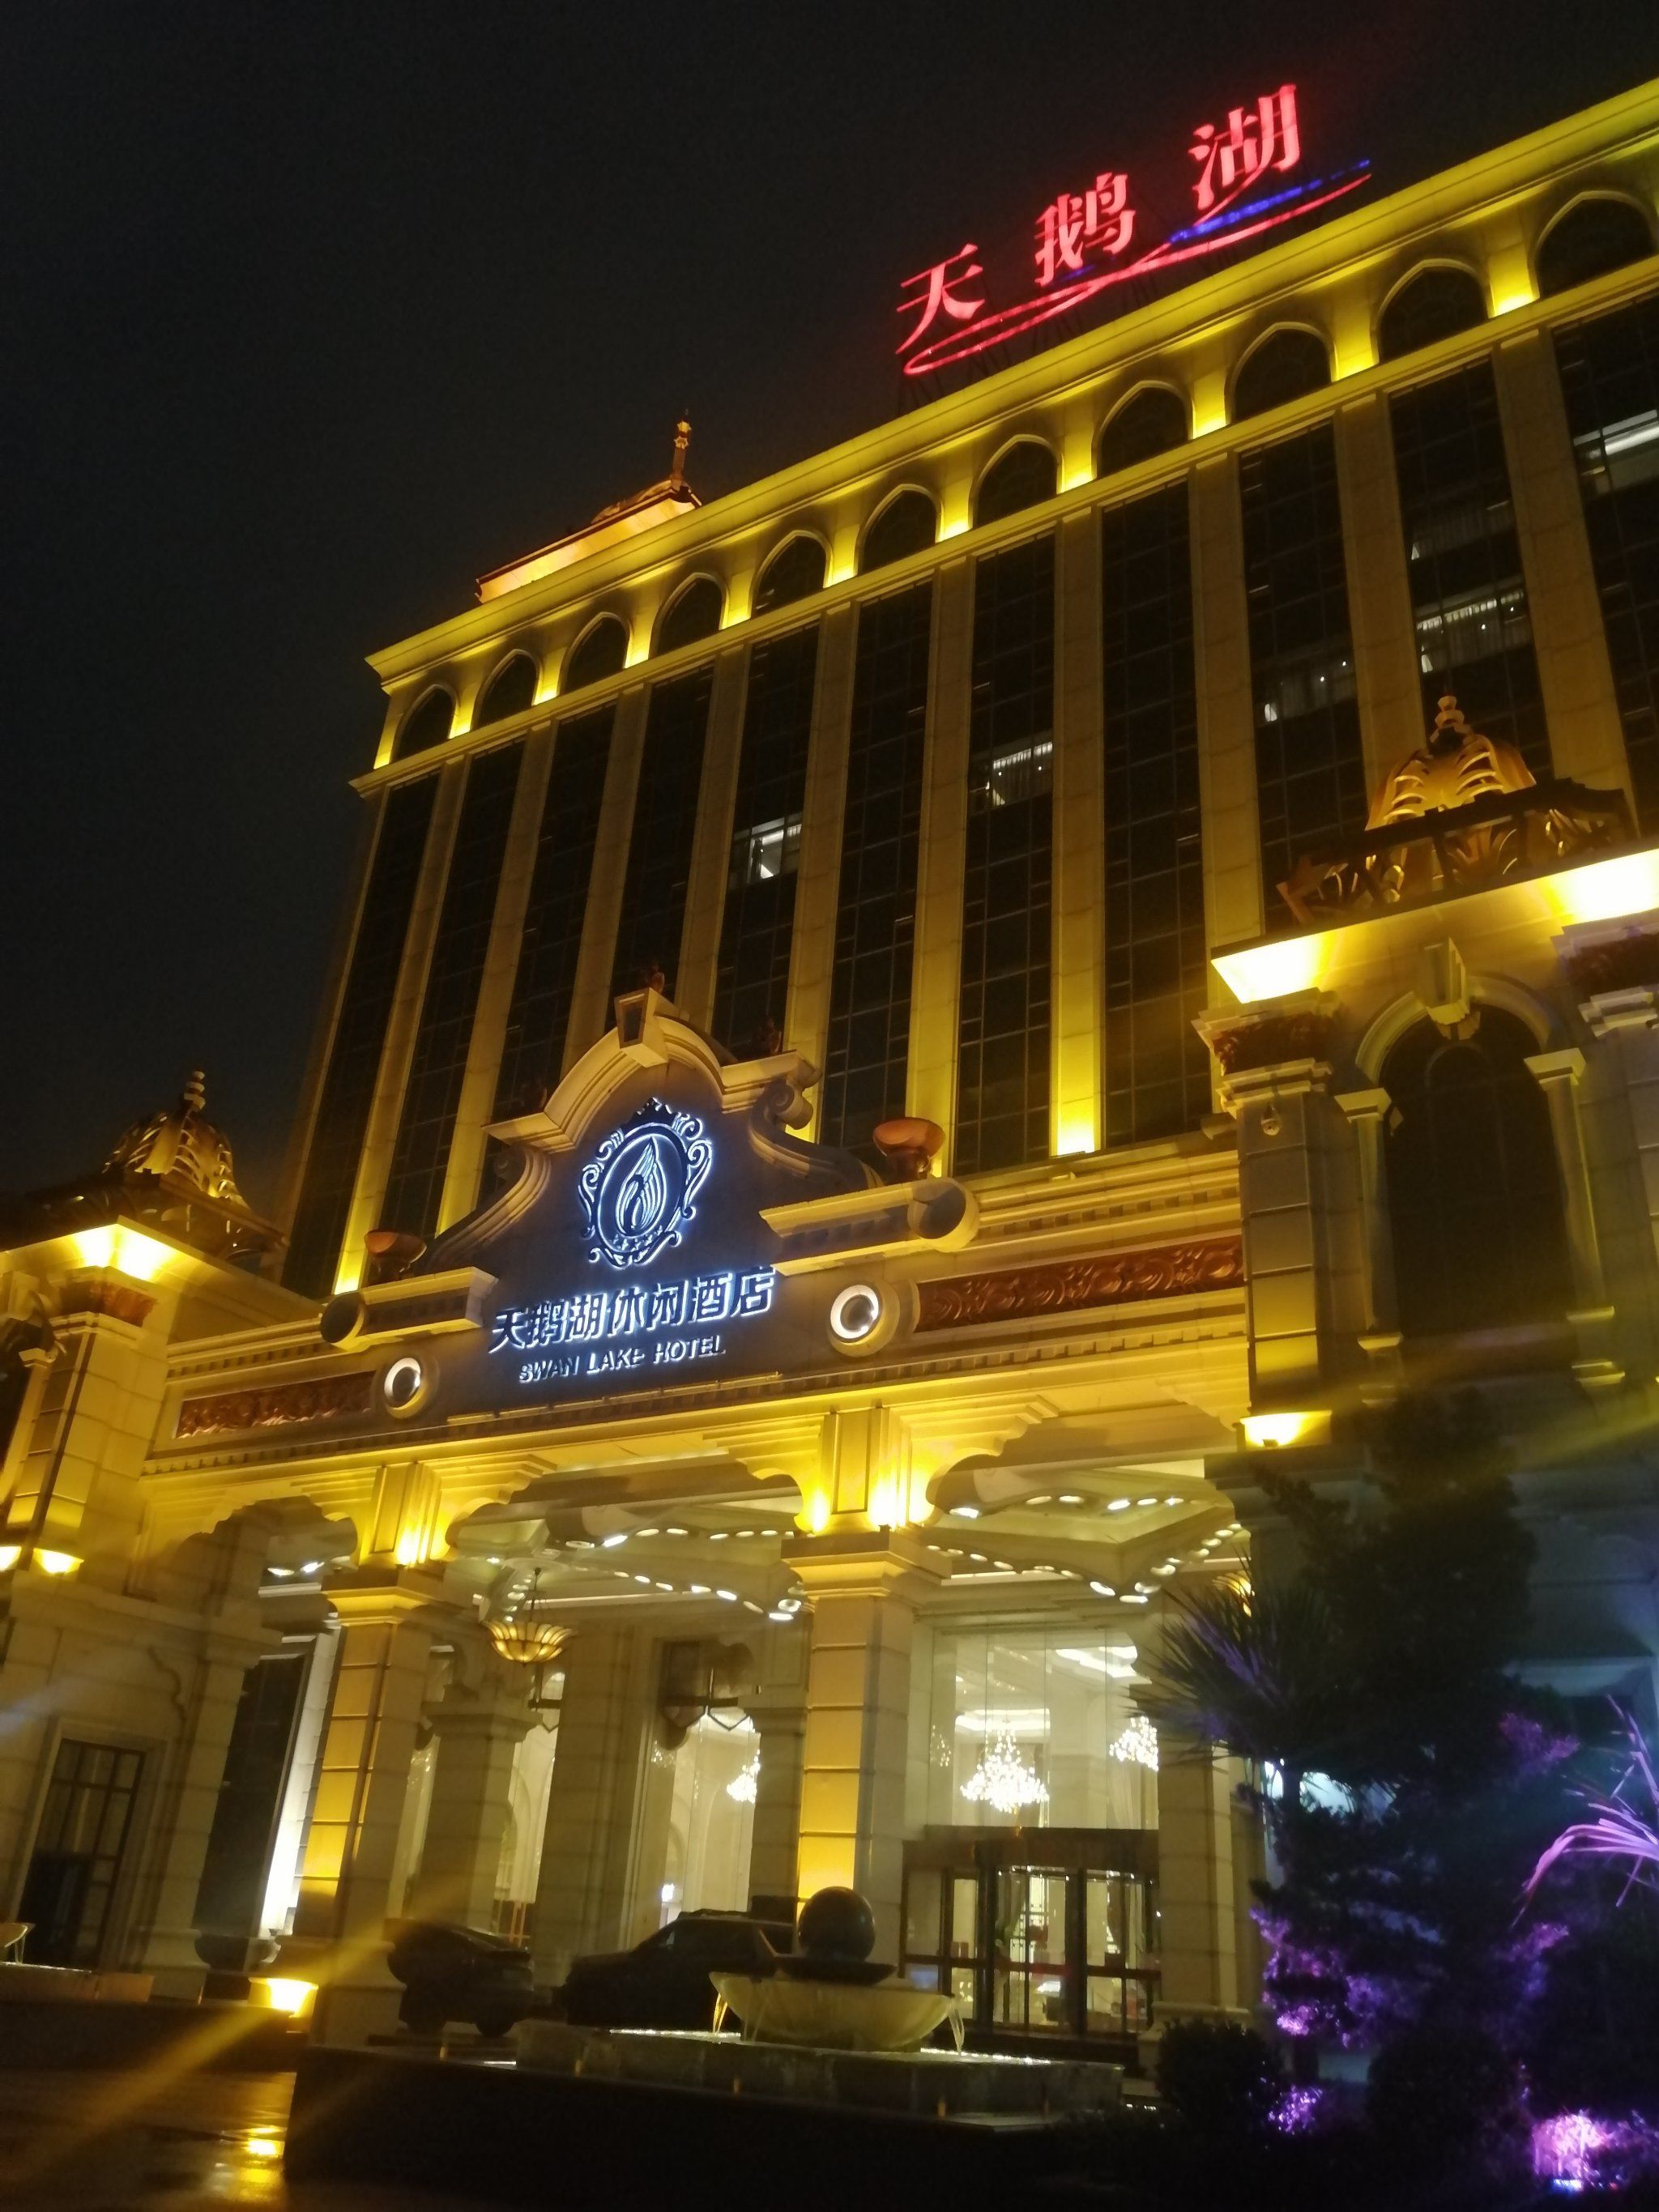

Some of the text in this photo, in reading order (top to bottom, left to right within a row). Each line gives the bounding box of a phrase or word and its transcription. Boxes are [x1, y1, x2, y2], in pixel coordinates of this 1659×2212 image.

[896, 83, 1301, 354] 天鹅湖
[489, 1264, 776, 1353] 天鹅湖休闲酒店
[519, 1335, 727, 1383] SWAN LAKE HOTEL
